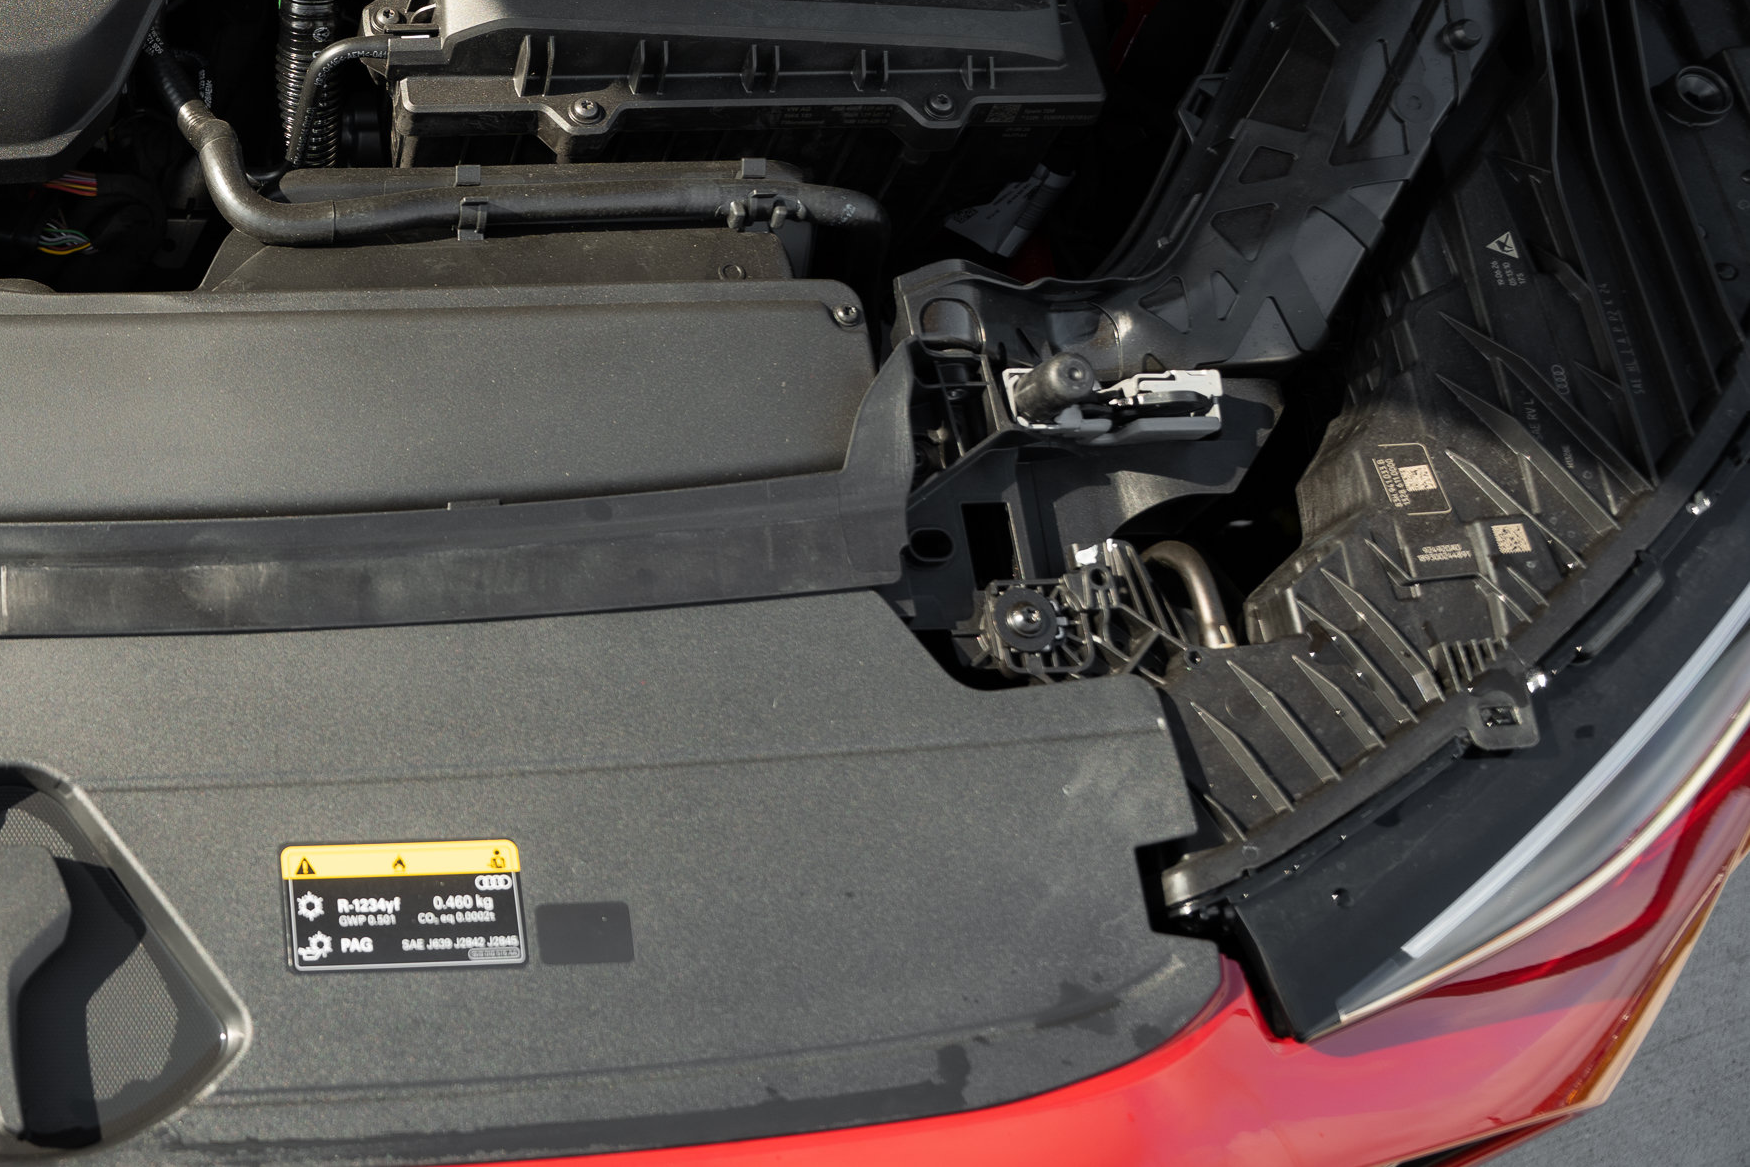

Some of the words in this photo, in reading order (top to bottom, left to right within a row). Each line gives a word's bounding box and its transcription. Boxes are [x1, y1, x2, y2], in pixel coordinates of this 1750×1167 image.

[337, 896, 401, 914] R-1234yf
[475, 895, 494, 910] kg
[339, 914, 366, 927] GWP
[441, 912, 455, 925] eq
[341, 938, 373, 953] PAG
[401, 938, 424, 951] SAE
